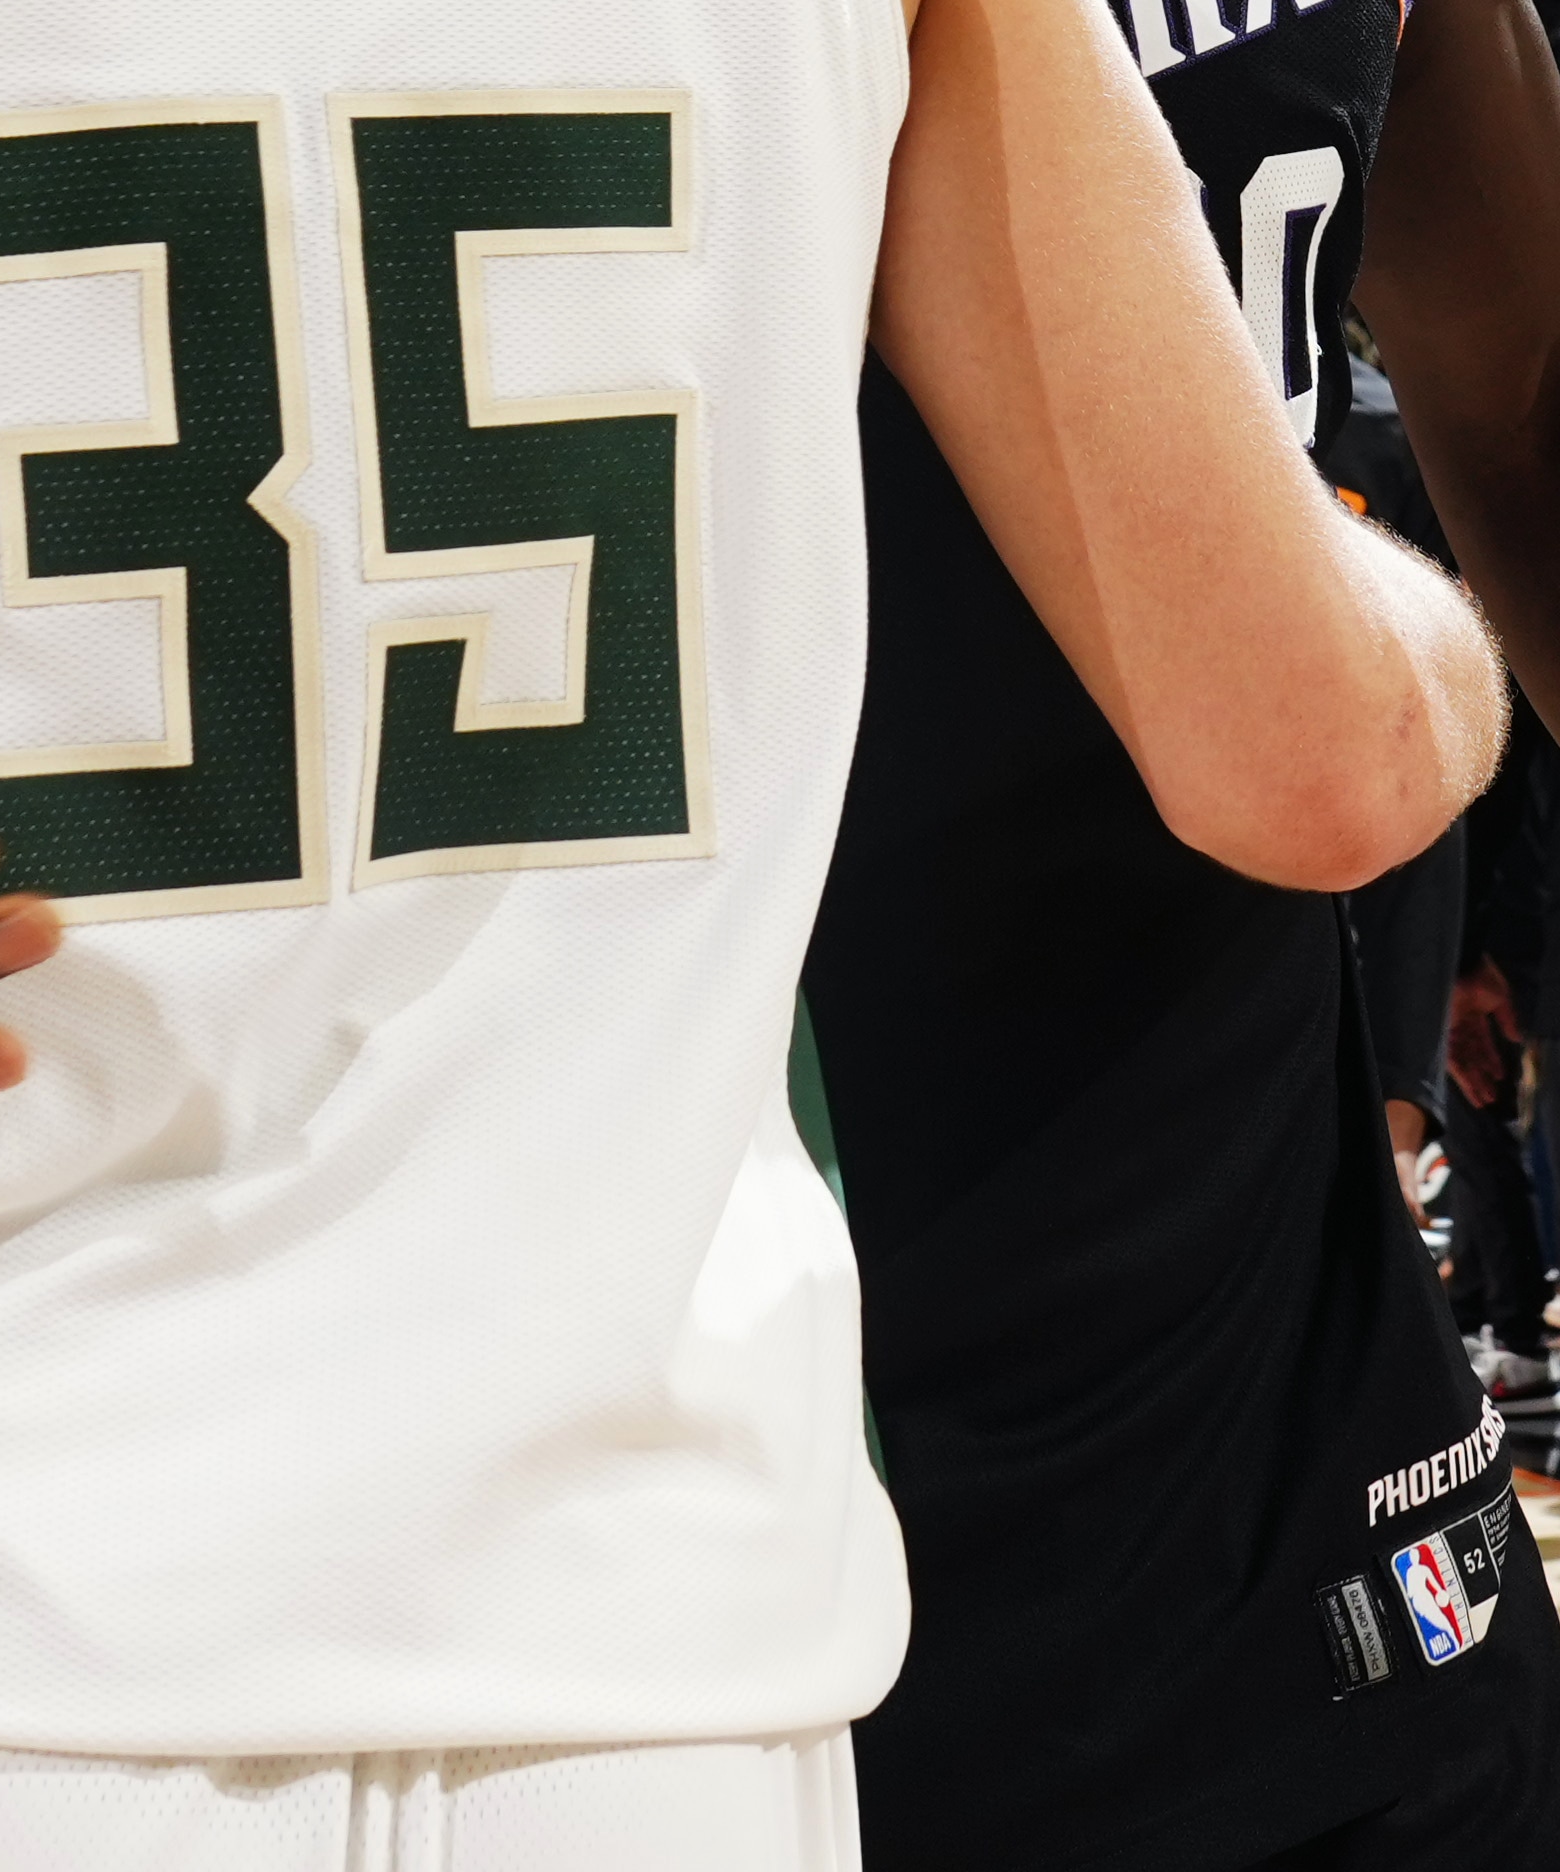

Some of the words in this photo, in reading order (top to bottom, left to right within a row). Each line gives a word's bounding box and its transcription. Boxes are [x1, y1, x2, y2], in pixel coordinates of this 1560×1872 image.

[1188, 145, 1346, 450] 0
[1367, 1426, 1488, 1528] PHOENIX
[1463, 1547, 1486, 1575] 52
[1428, 1631, 1453, 1659] NBA
